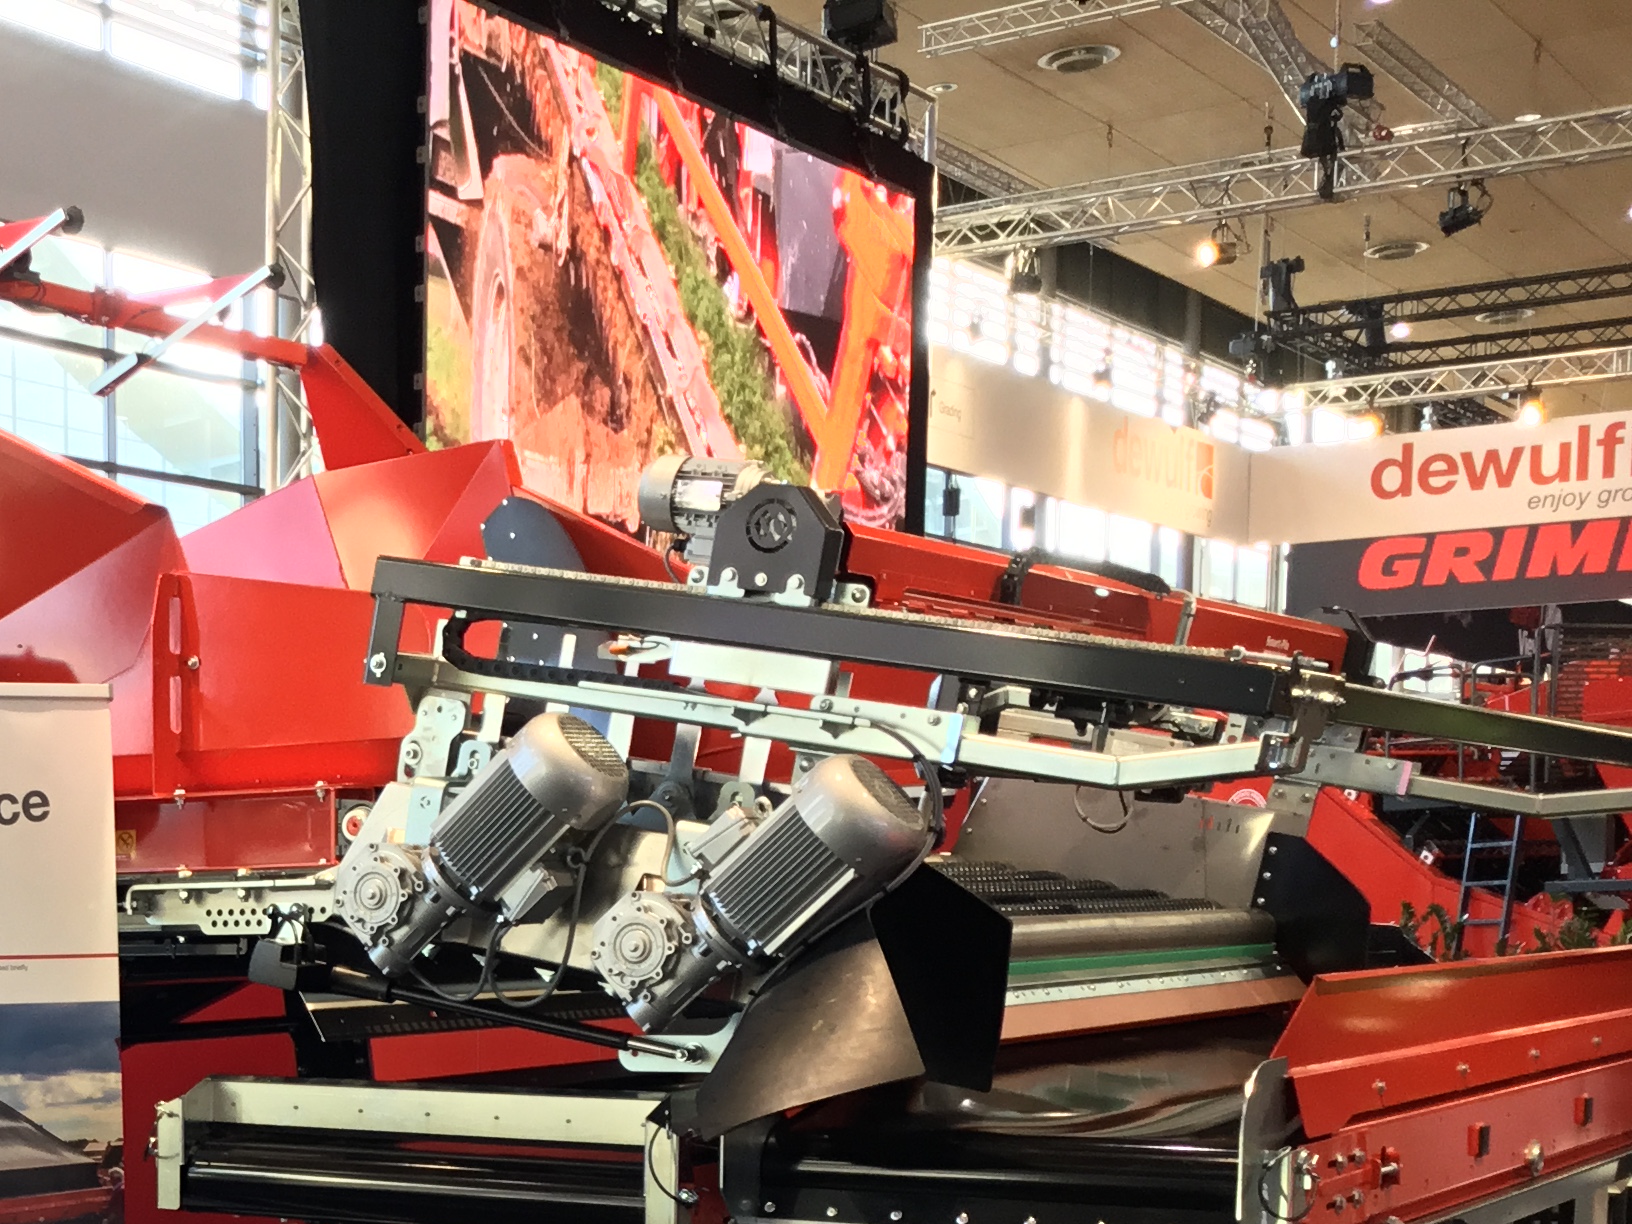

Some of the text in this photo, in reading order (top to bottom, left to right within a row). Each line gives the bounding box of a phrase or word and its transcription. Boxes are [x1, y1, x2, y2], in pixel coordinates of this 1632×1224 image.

[1371, 421, 1626, 500] dewulf
[1527, 488, 1592, 513] enjoy
[1358, 518, 1632, 591] GRIM
